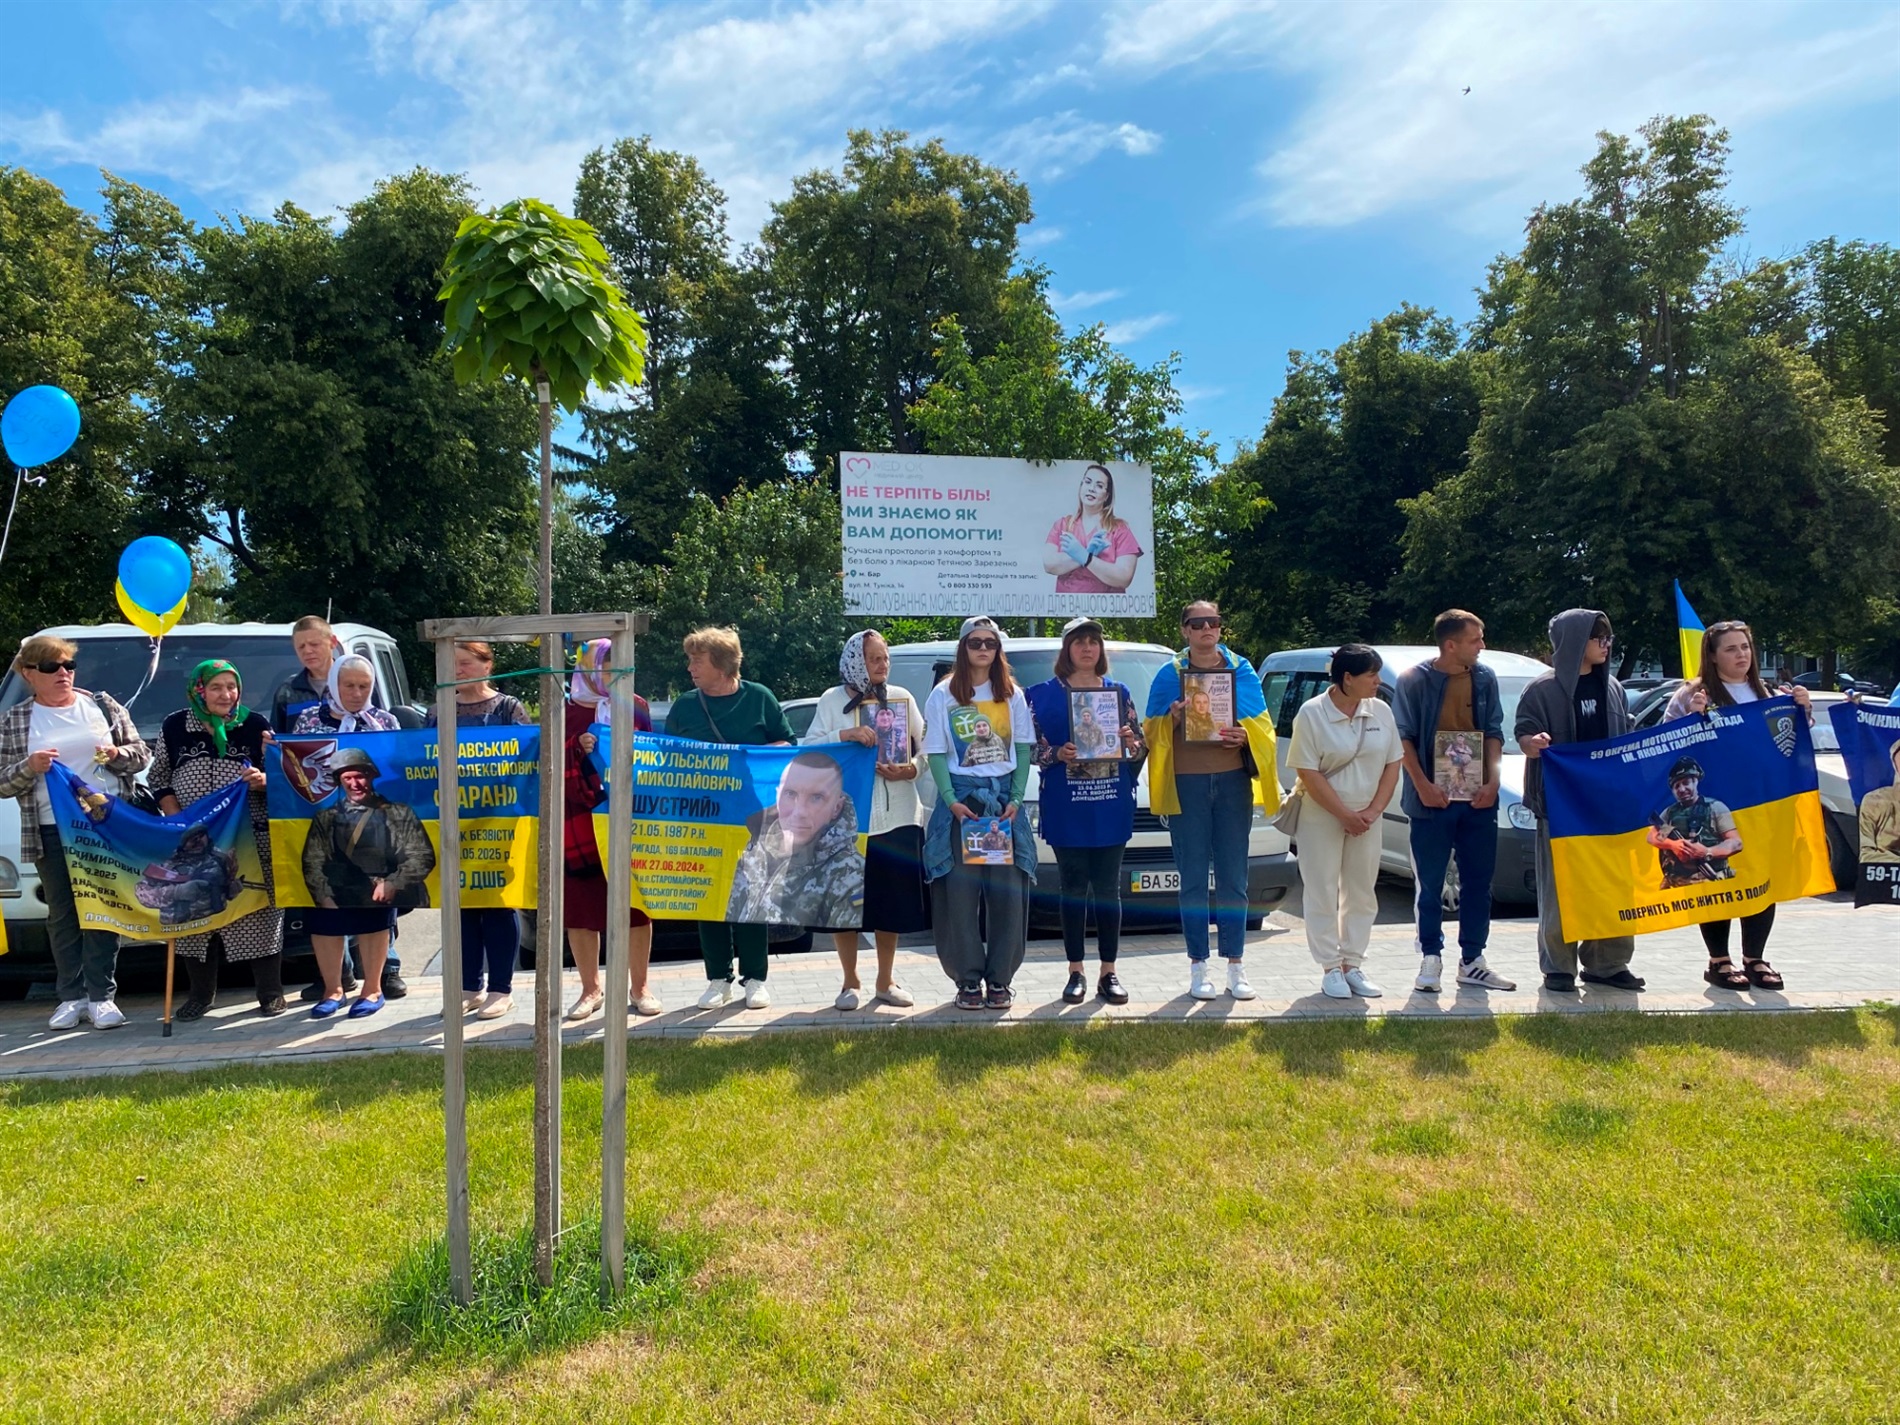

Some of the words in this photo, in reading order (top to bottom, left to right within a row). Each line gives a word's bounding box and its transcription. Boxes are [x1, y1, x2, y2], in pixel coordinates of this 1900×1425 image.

[846, 485, 869, 498] НЕ
[873, 486, 943, 500] ТЕРПІТЬ
[947, 489, 991, 501] БІЛЬ!
[846, 506, 873, 518] МИ
[878, 506, 950, 520] ЗНАЄМО
[955, 509, 977, 521] ЯК
[847, 526, 885, 539] ВАМ
[890, 527, 1003, 541] ДОПОМОГТИ!
[847, 546, 883, 556] Сучасна
[884, 548, 936, 557] проктологія
[944, 548, 991, 558] комфортом
[847, 557, 863, 565] без
[864, 557, 887, 566] болю
[896, 558, 935, 567] лікаркою
[937, 559, 972, 567] Тетяною
[867, 570, 881, 578] Бар
[937, 572, 970, 580] Детальна
[929, 593, 959, 613] МОЖЕ
[961, 593, 985, 613] БУТИ
[987, 594, 1046, 616] ШКІДЛИВИМ
[1048, 594, 1066, 615] ДЛЯ
[1069, 594, 1107, 614] ВАШОГО
[1590, 749, 1604, 760] 59
[1605, 741, 1641, 758] ОКРЕМА
[1642, 722, 1704, 749] МОТОПІХОТНА
[424, 738, 520, 760] ТААВСЬКИЙ
[1637, 745, 1669, 761] ЯКОВА
[633, 749, 729, 771] РИКУЛЬСЬКИЙ
[636, 769, 743, 792] МИКОЛАЙОВИЧ»
[632, 794, 721, 818] ШУСТРИЙ»
[470, 829, 515, 841] БЕЗВІСТИ
[632, 823, 689, 838] 21.05.1987
[632, 843, 662, 855] РИГАДА,
[665, 845, 678, 855] 169
[680, 845, 723, 857] БАТАЛЬЙОН
[631, 859, 647, 870] НИК
[649, 859, 698, 872] 27.06.2024
[470, 870, 507, 891] ДШБ
[1141, 874, 1161, 889] BA
[1164, 873, 1181, 888] 58
[1890, 884, 1900, 899] 1
[668, 901, 698, 911] ОБЛАСТІ
[1618, 902, 1670, 922] ПОВЕРНІТЬ
[1671, 898, 1695, 912] МОЄ
[1695, 891, 1734, 908] ЖИТТЯ
[1736, 889, 1744, 902] З
